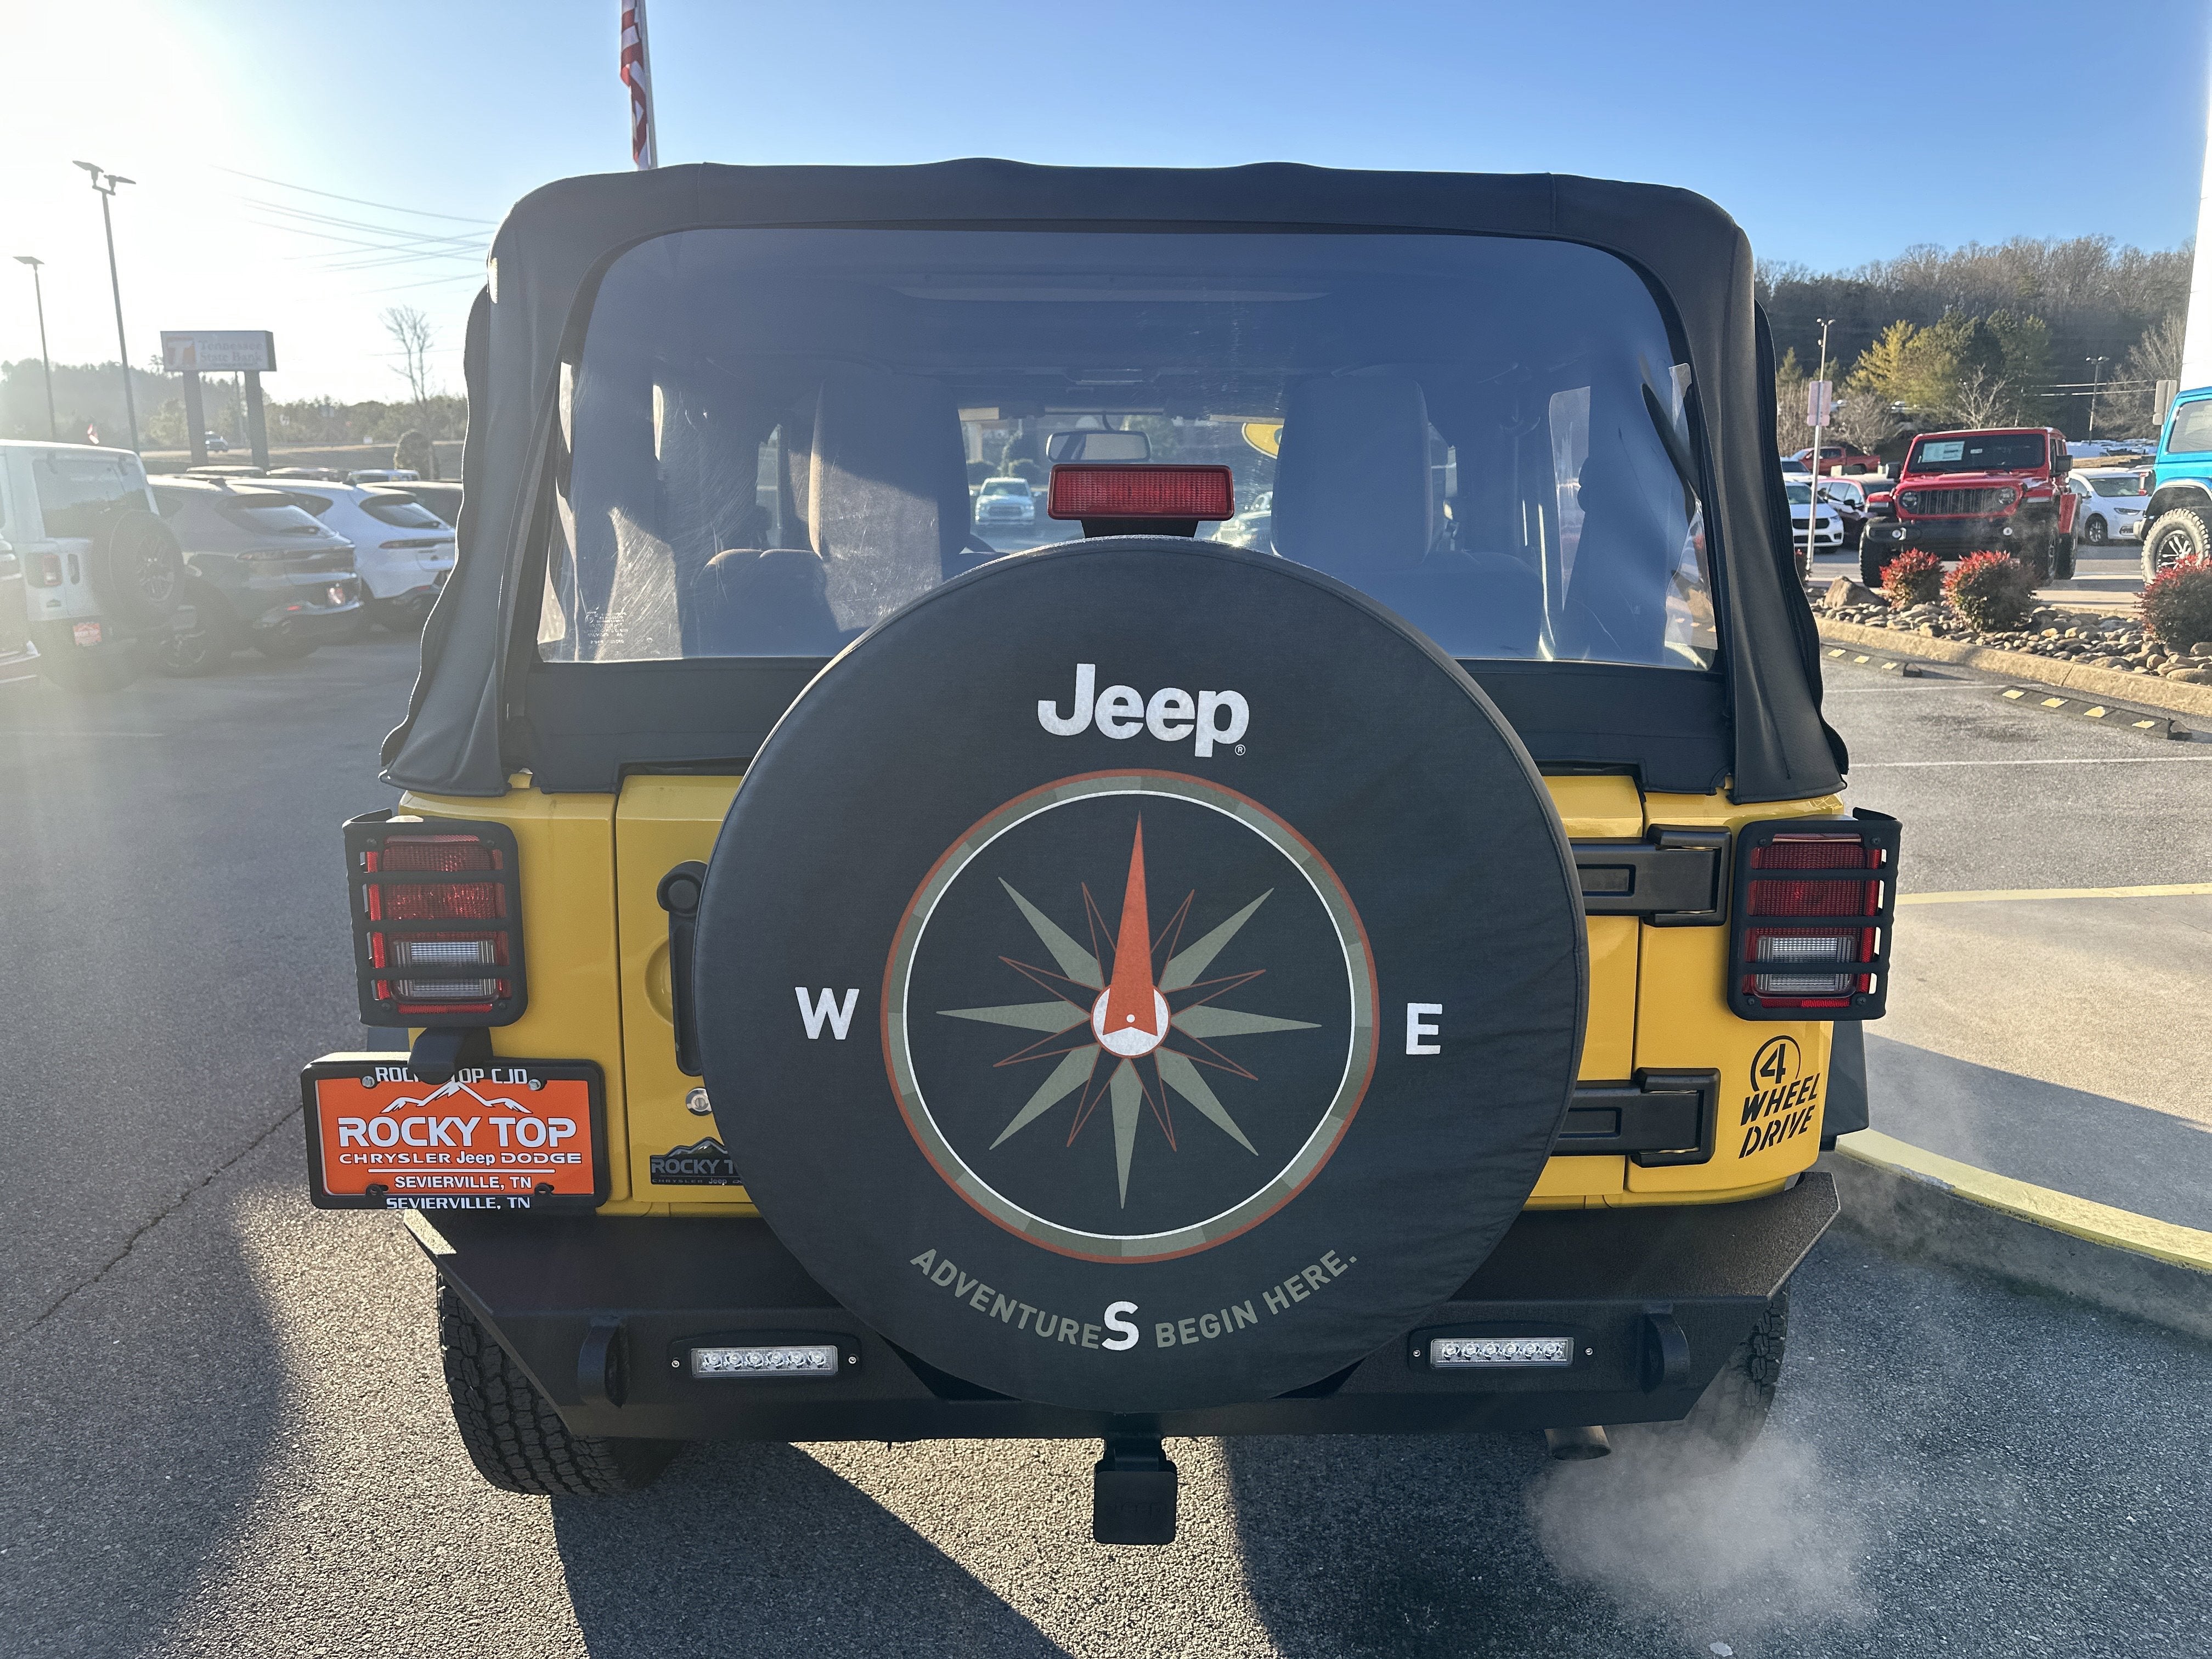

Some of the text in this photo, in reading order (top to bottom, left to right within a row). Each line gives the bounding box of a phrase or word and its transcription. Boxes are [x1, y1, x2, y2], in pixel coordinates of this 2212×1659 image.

[198, 340, 263, 350] Tennessee
[200, 351, 263, 362] State Bank
[1037, 663, 1250, 758] Jeep
[794, 986, 860, 1040] W
[1406, 1002, 1443, 1055] E
[375, 1066, 528, 1084] ROC OP CJD
[1759, 1043, 1786, 1085] 4
[1740, 1072, 1821, 1126] WHEEL
[337, 1117, 577, 1147] ROCKY TOP
[1738, 1104, 1816, 1159] DRIVE
[339, 1151, 582, 1166] CHRYSLER Jeep DODGE
[651, 1159, 720, 1175] ROCKY
[394, 1176, 532, 1190] SEVIERVILLE, TN
[386, 1197, 531, 1210] SEVIERVILLE, TN
[1155, 1300, 1259, 1348] BEGIN
[1262, 1249, 1357, 1315] HERE.
